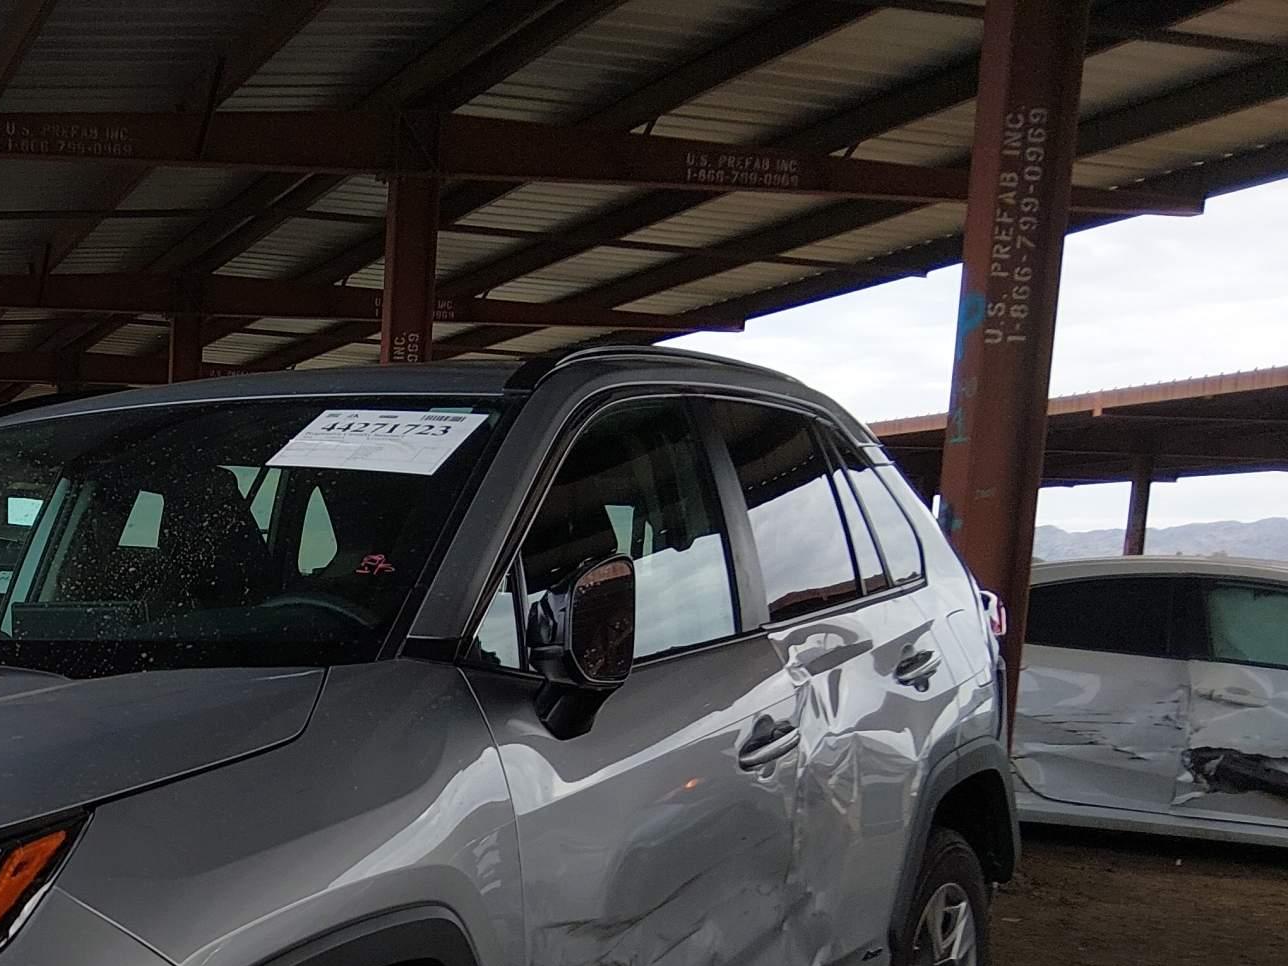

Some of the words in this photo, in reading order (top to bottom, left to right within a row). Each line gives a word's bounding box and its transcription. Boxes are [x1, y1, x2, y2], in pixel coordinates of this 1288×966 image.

[991, 170, 1019, 277] PREFAB
[1006, 106, 1048, 343] 1-866-799-0969
[983, 292, 1006, 345] U.S.
[321, 421, 452, 437] 44271723
